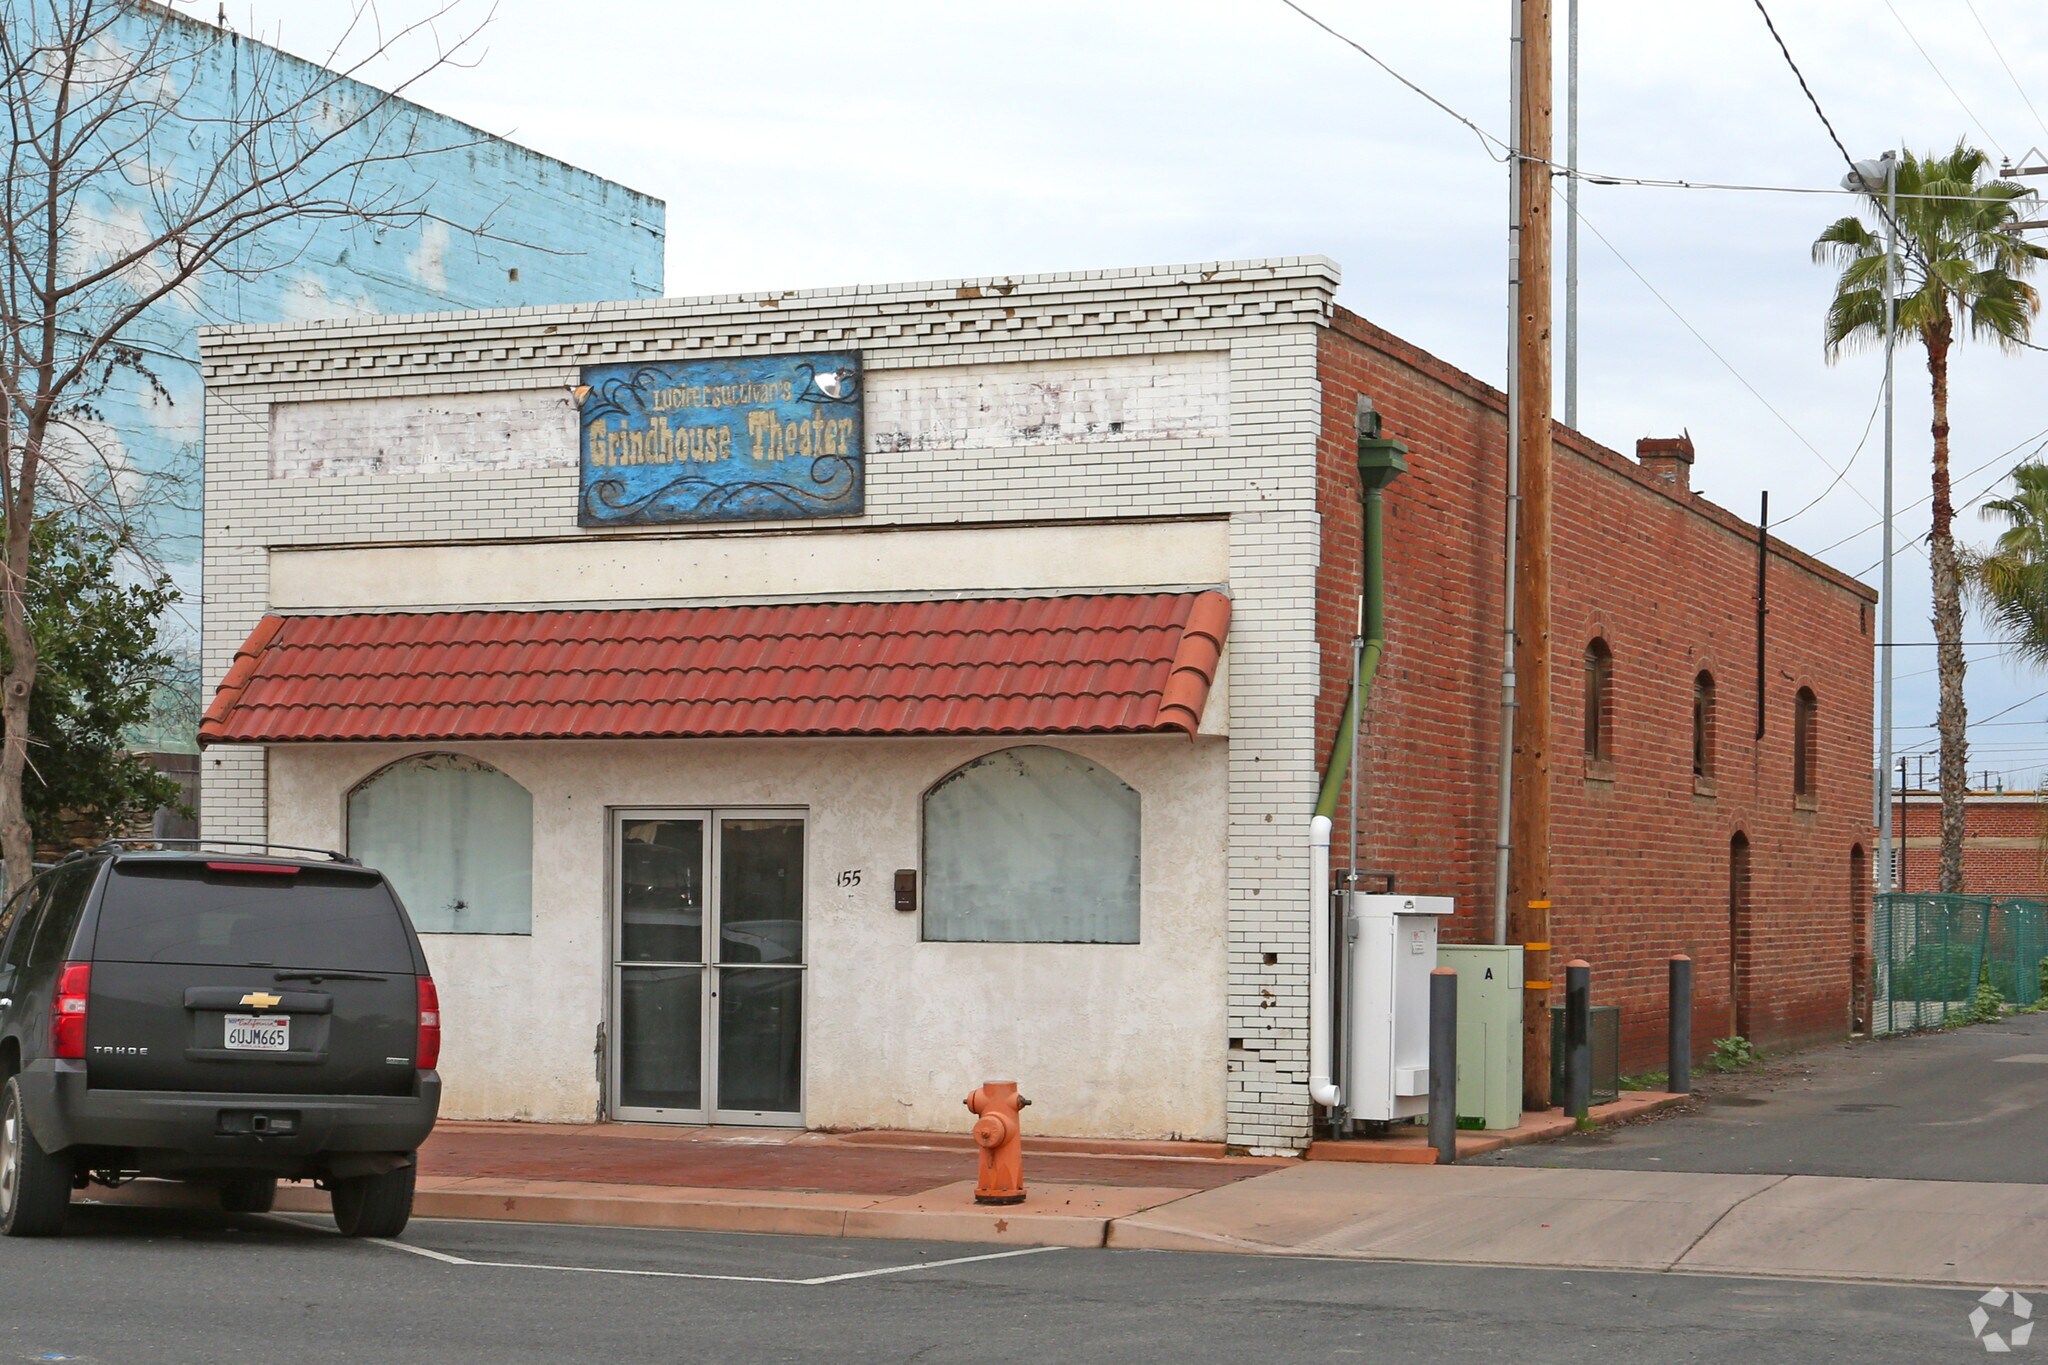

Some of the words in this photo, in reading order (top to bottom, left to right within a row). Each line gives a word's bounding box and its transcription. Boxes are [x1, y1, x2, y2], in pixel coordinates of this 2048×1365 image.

[590, 417, 731, 467] Grindhouse
[748, 409, 853, 461] Theater
[837, 869, 861, 888] 155
[1484, 967, 1494, 980] A
[229, 1028, 285, 1046] 6UJM665
[93, 1046, 148, 1055] TAHOE
